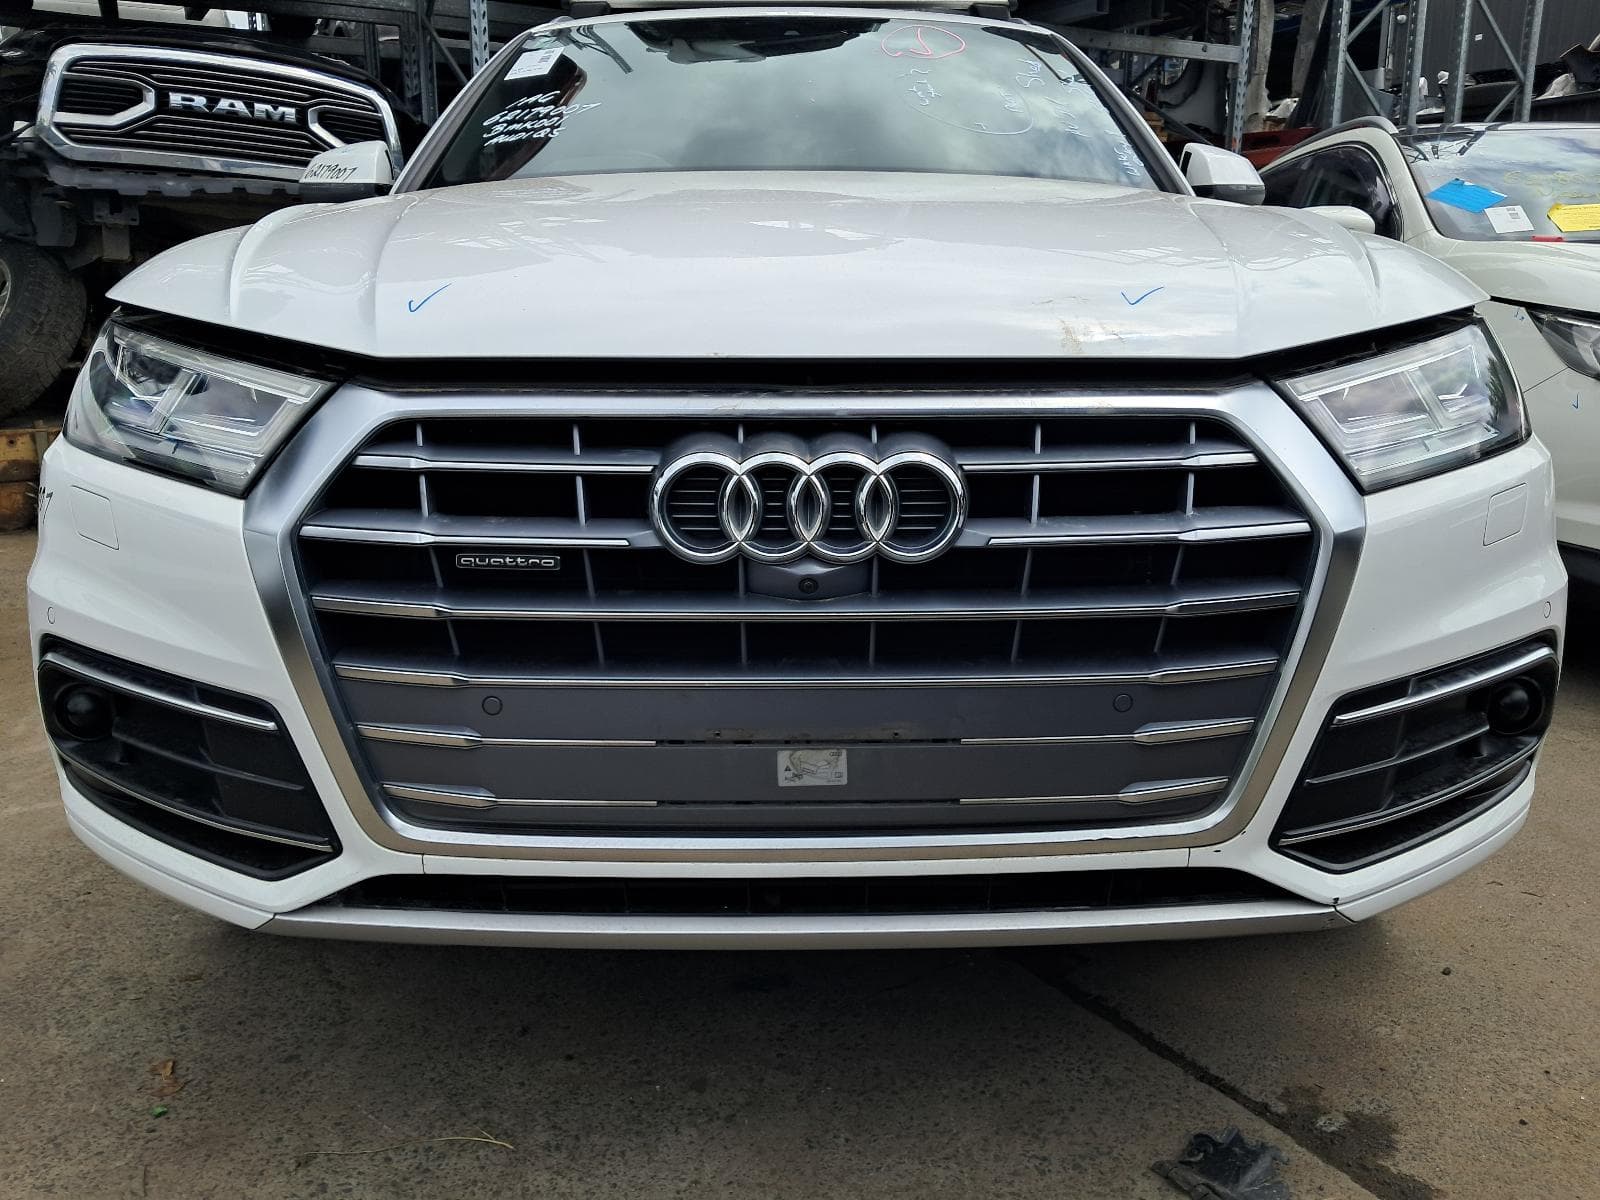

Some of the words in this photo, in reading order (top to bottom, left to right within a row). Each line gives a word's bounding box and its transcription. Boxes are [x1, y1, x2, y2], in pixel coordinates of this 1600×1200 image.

[168, 91, 297, 124] RAM
[482, 102, 602, 126] 62179007
[460, 556, 555, 568] quattro
